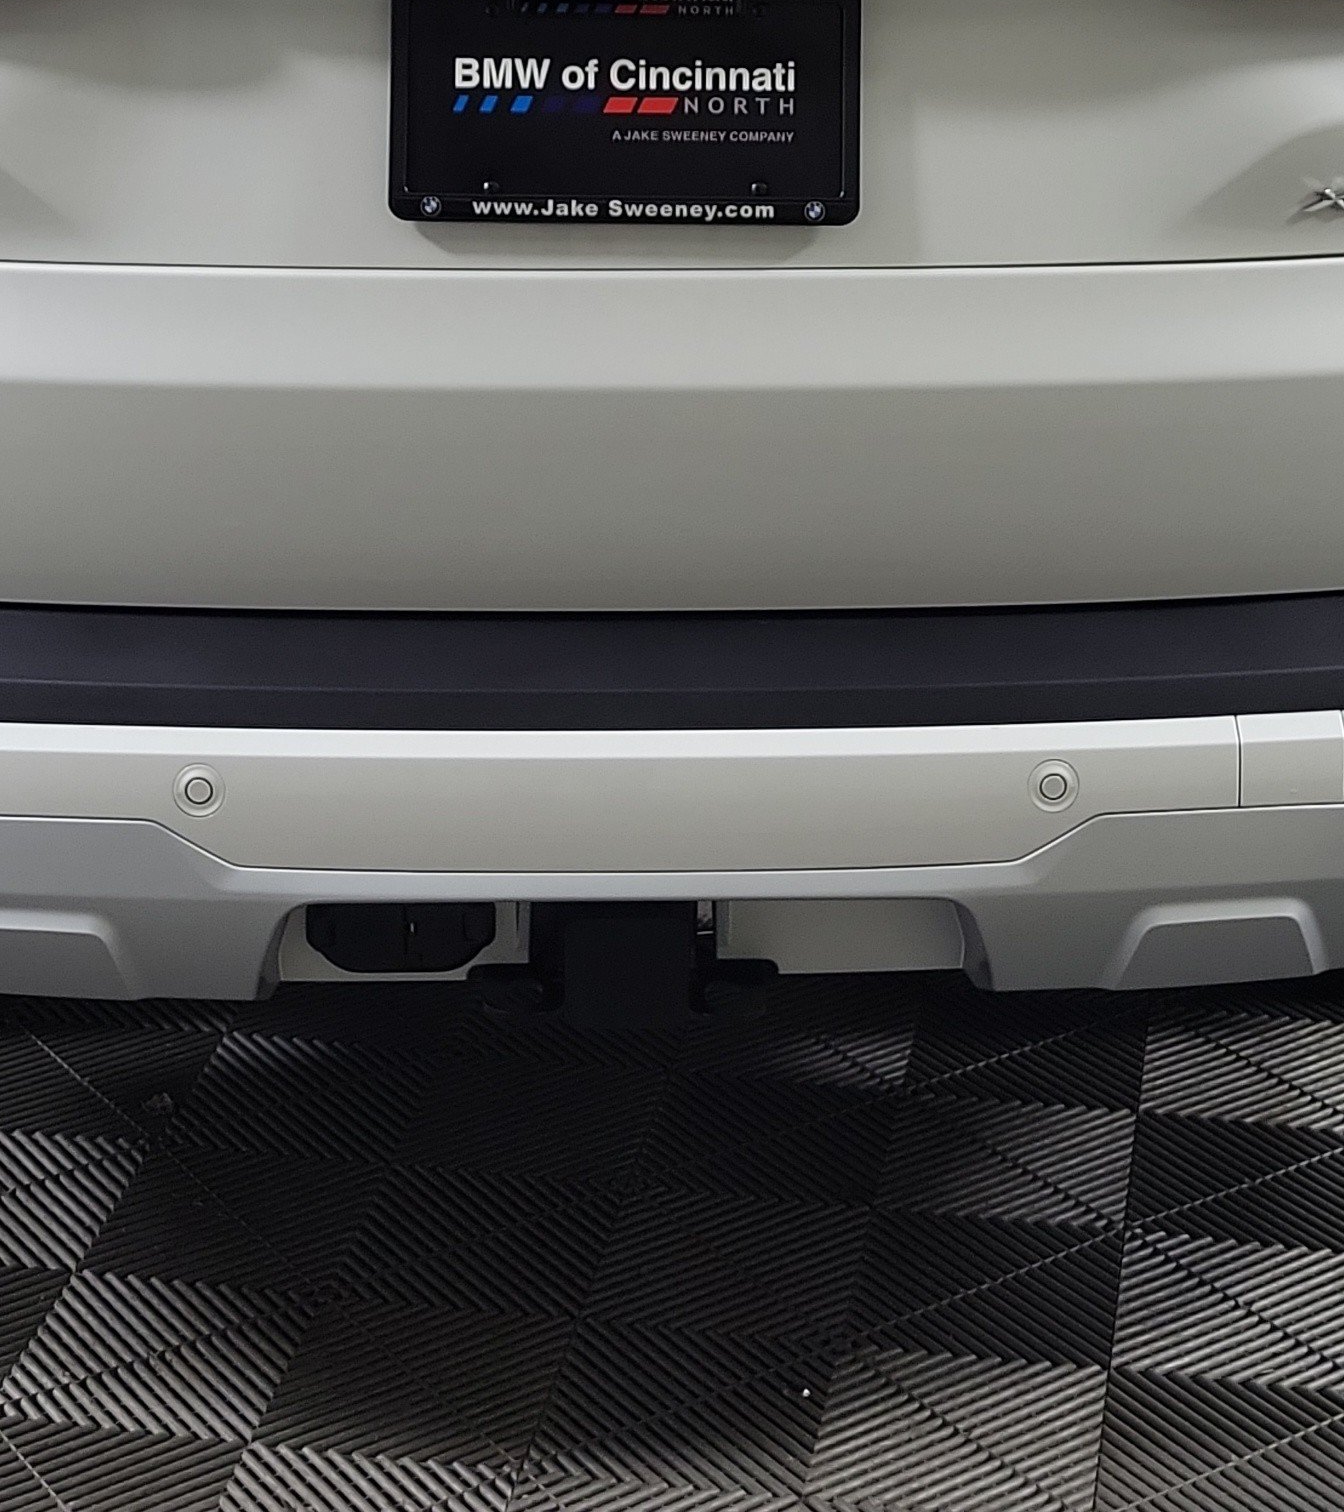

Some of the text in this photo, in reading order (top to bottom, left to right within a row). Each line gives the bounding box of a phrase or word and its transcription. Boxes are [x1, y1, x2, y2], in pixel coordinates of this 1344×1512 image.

[678, 5, 734, 15] NORTH
[454, 58, 796, 92] BMW of Cincinnati
[684, 97, 794, 115] NORTH
[612, 130, 794, 143] A JAKE SWEENEY COMPANY
[472, 199, 774, 221] www.Jake Sweeney.com
